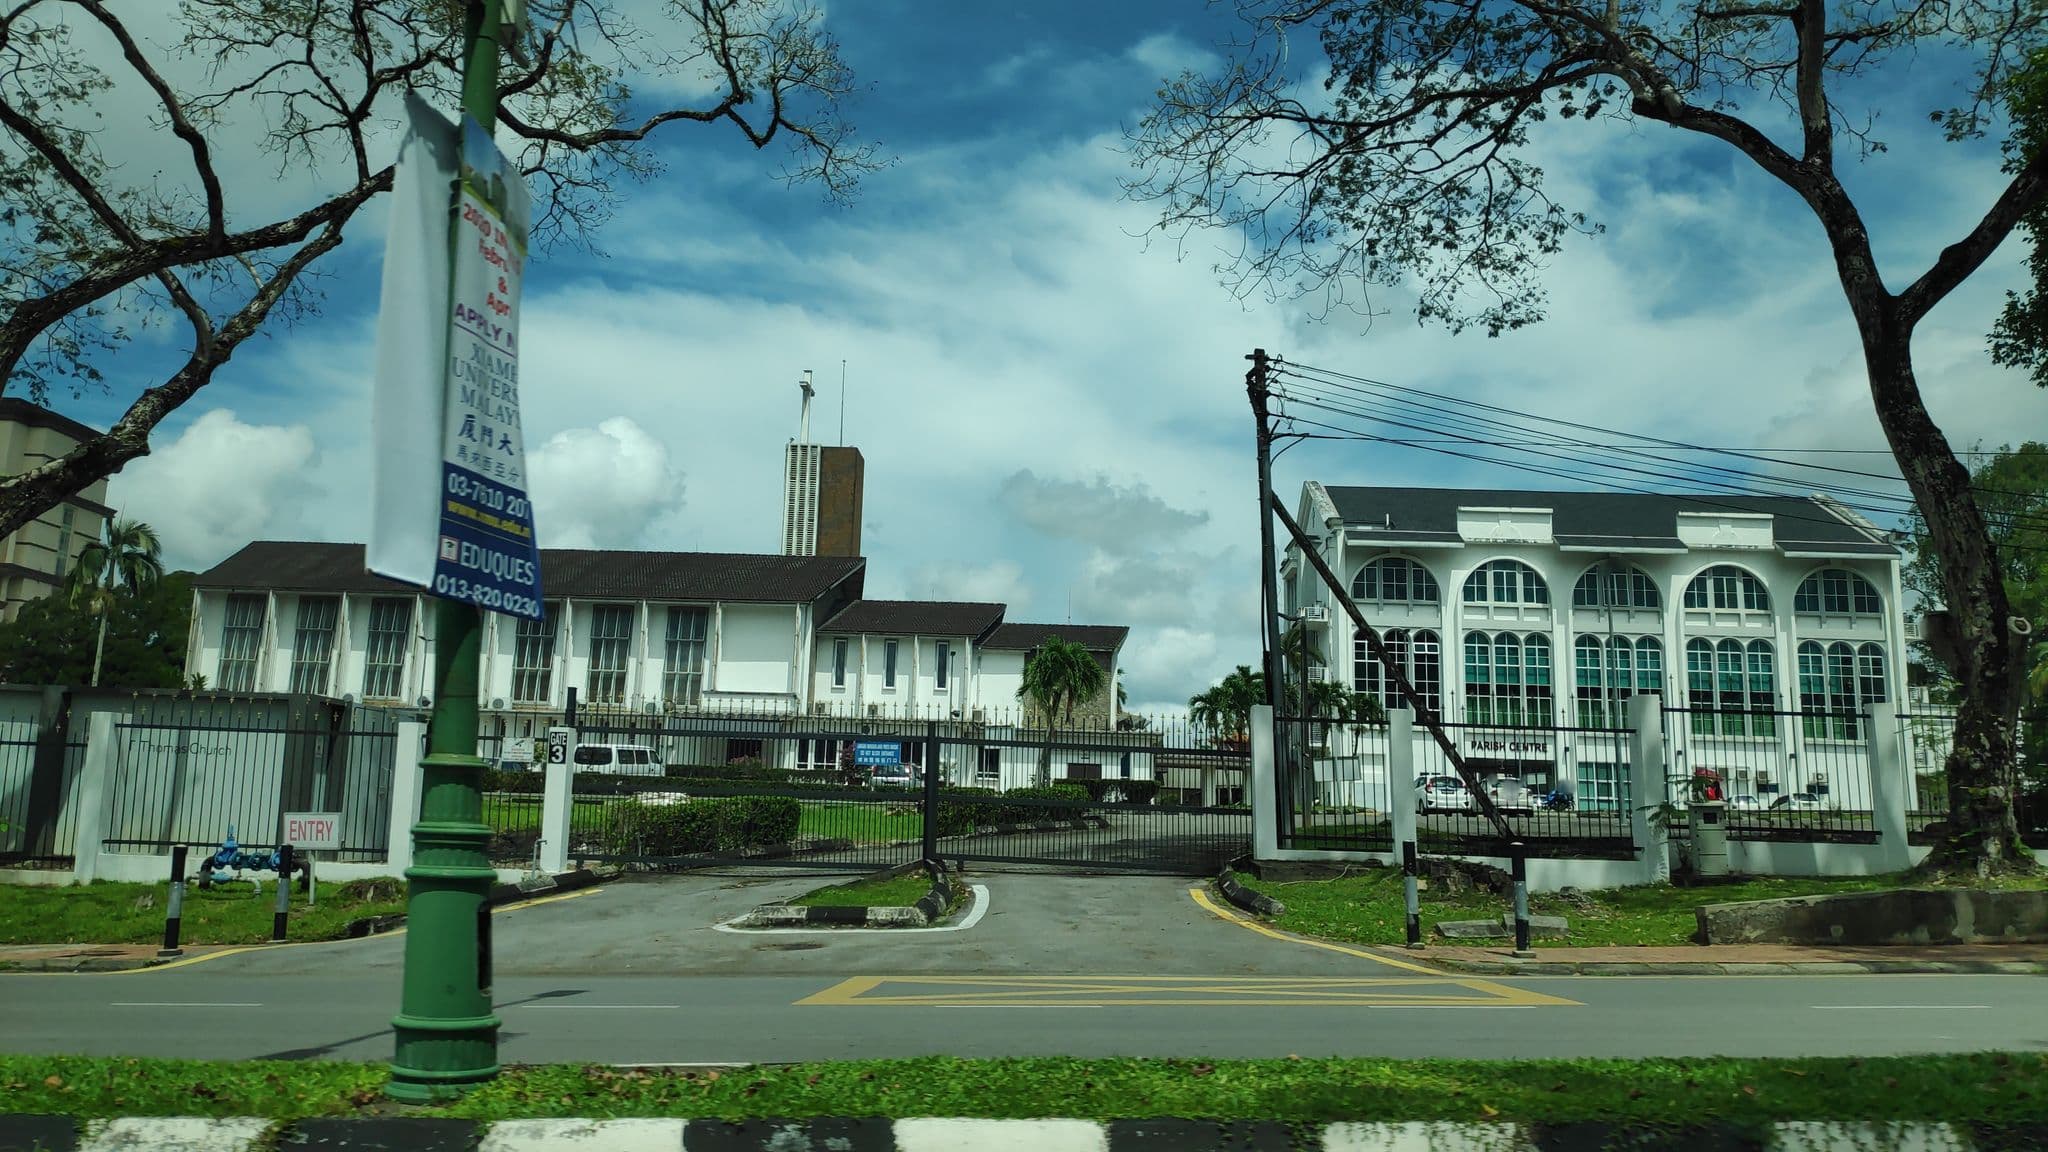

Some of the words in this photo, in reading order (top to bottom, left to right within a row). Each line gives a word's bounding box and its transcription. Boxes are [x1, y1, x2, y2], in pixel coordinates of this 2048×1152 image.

[455, 303, 502, 341] APPLY
[436, 573, 502, 608] 013-820
[551, 733, 567, 746] GATE
[1471, 740, 1506, 752] PARISH
[1509, 742, 1548, 753] CENTRE
[189, 742, 232, 756] Church
[551, 745, 564, 763] 3
[289, 820, 333, 842] ENTRY
